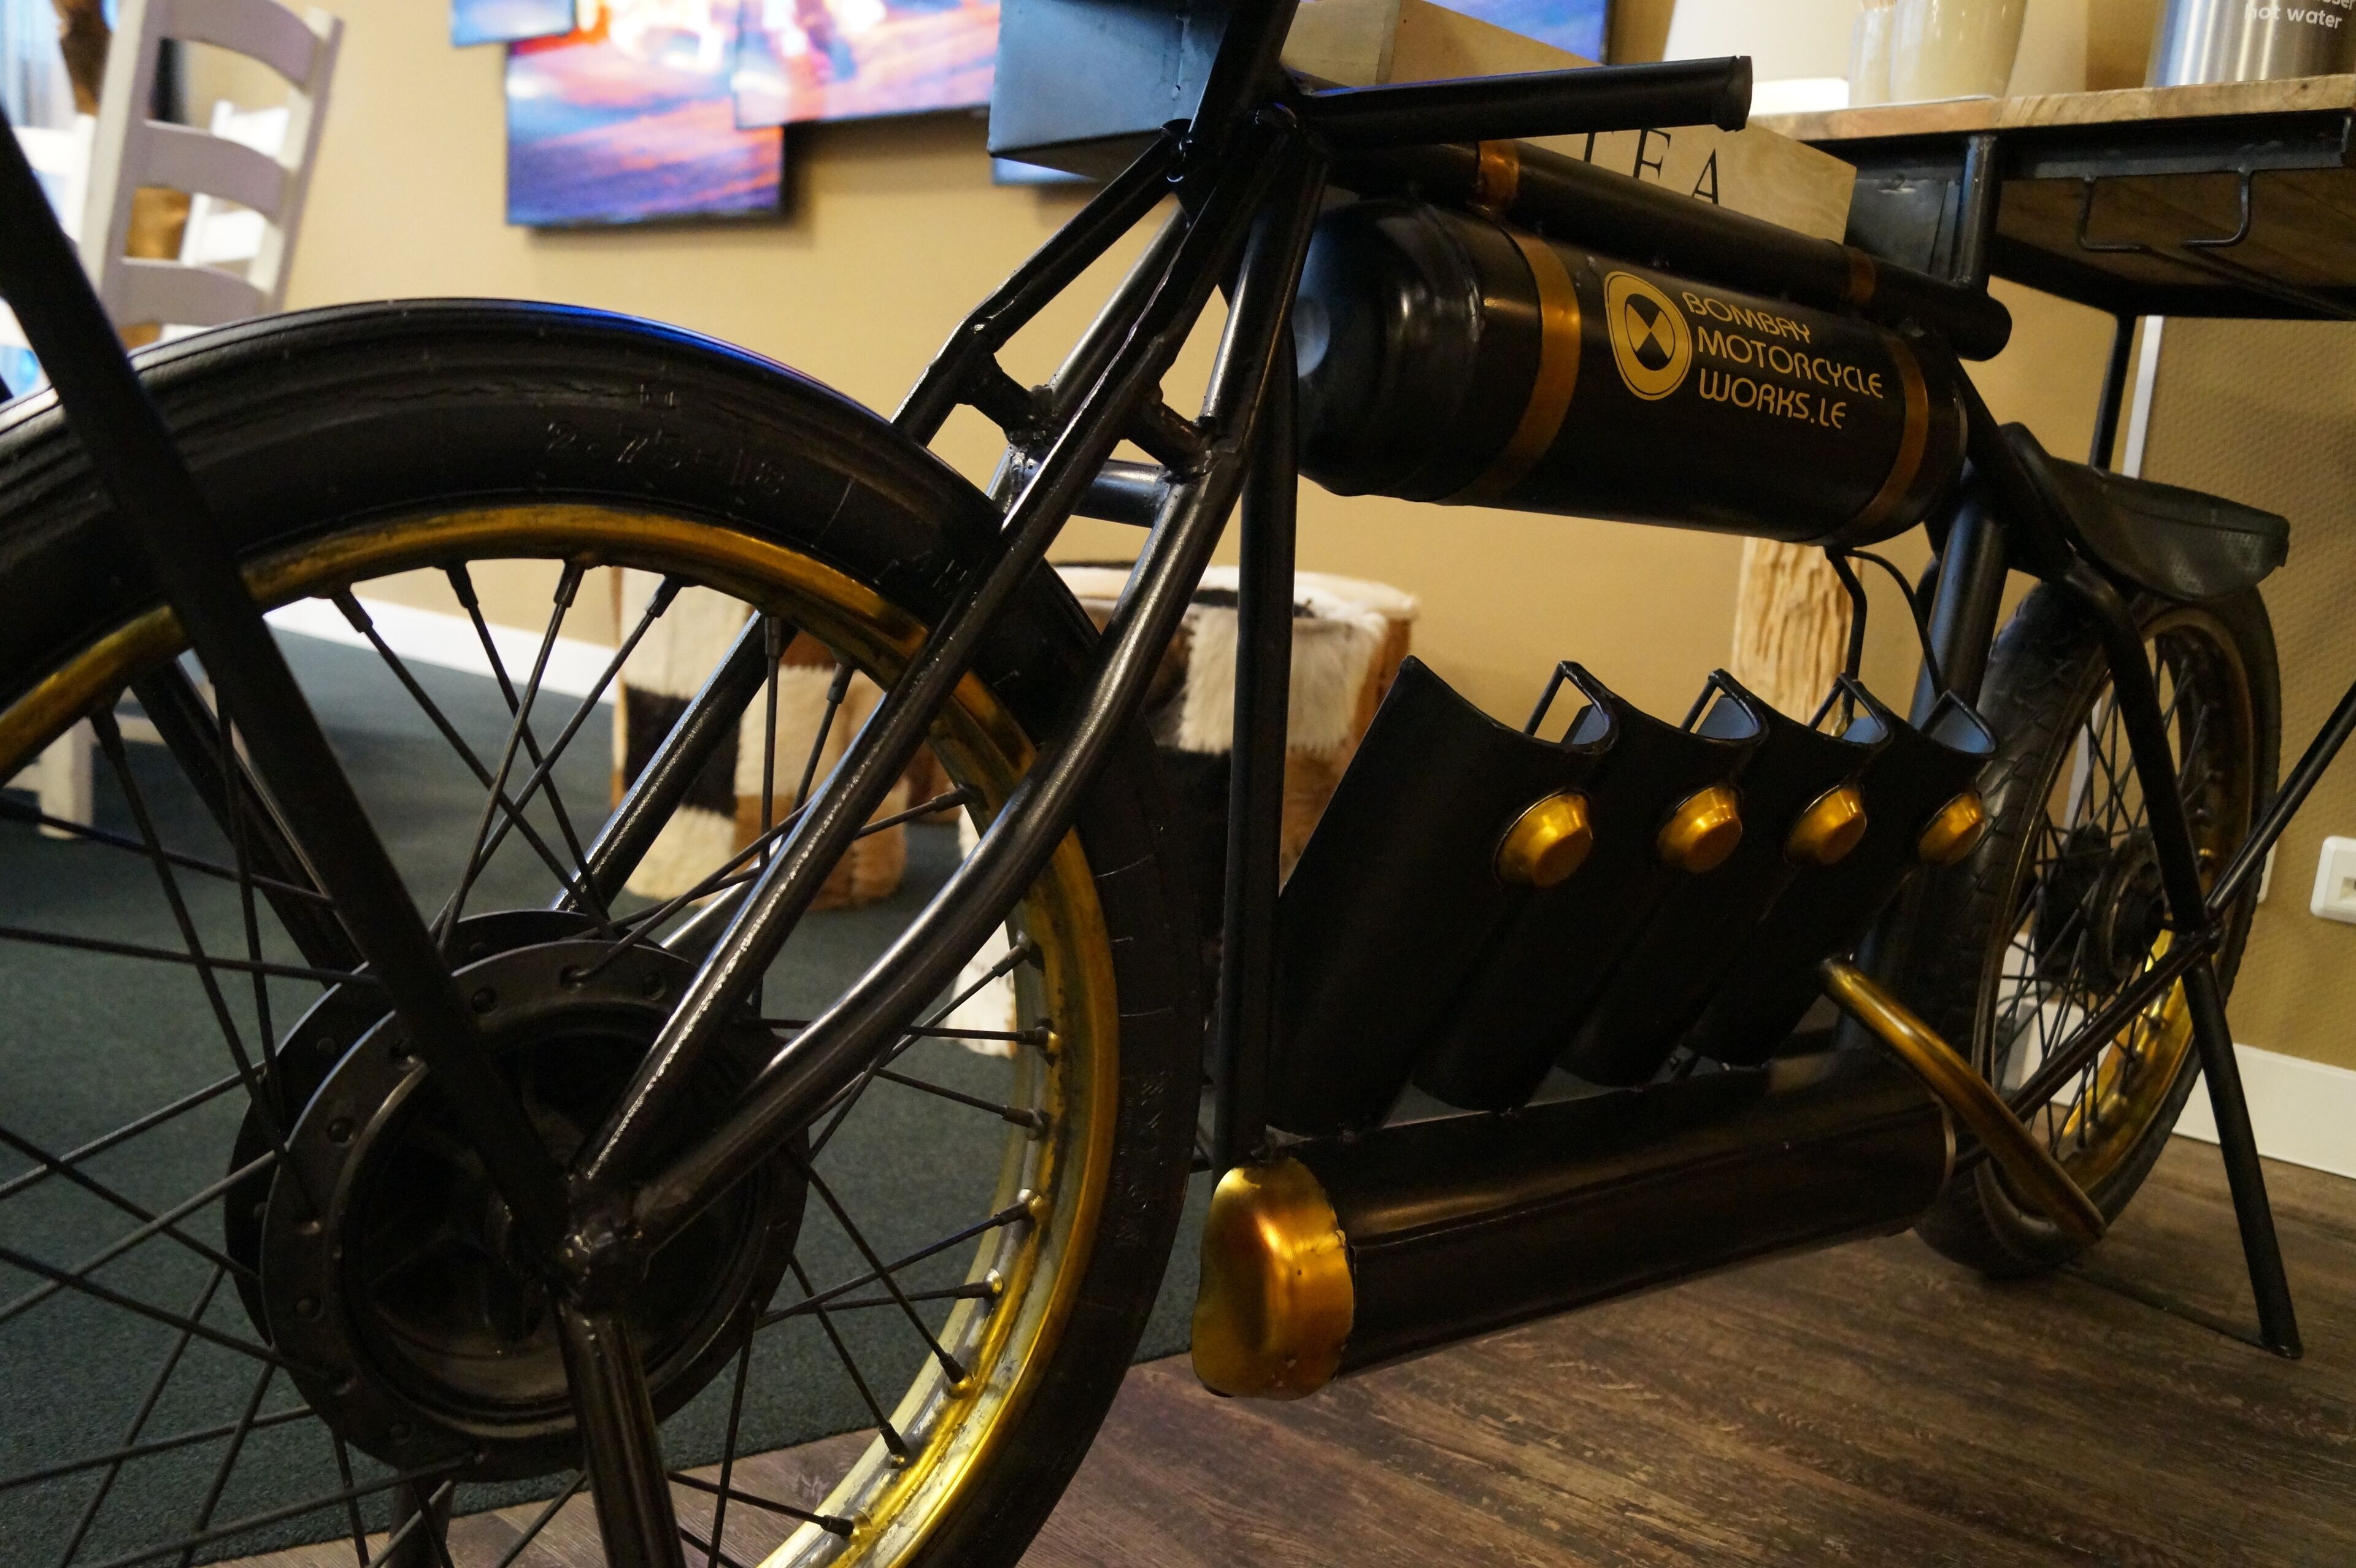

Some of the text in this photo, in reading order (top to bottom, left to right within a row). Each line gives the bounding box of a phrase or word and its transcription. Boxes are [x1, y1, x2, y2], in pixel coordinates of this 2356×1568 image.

[2244, 3, 2343, 29] hot water
[1682, 291, 1810, 344] BOMBAY
[1698, 326, 1884, 399] MOTORCYCLE
